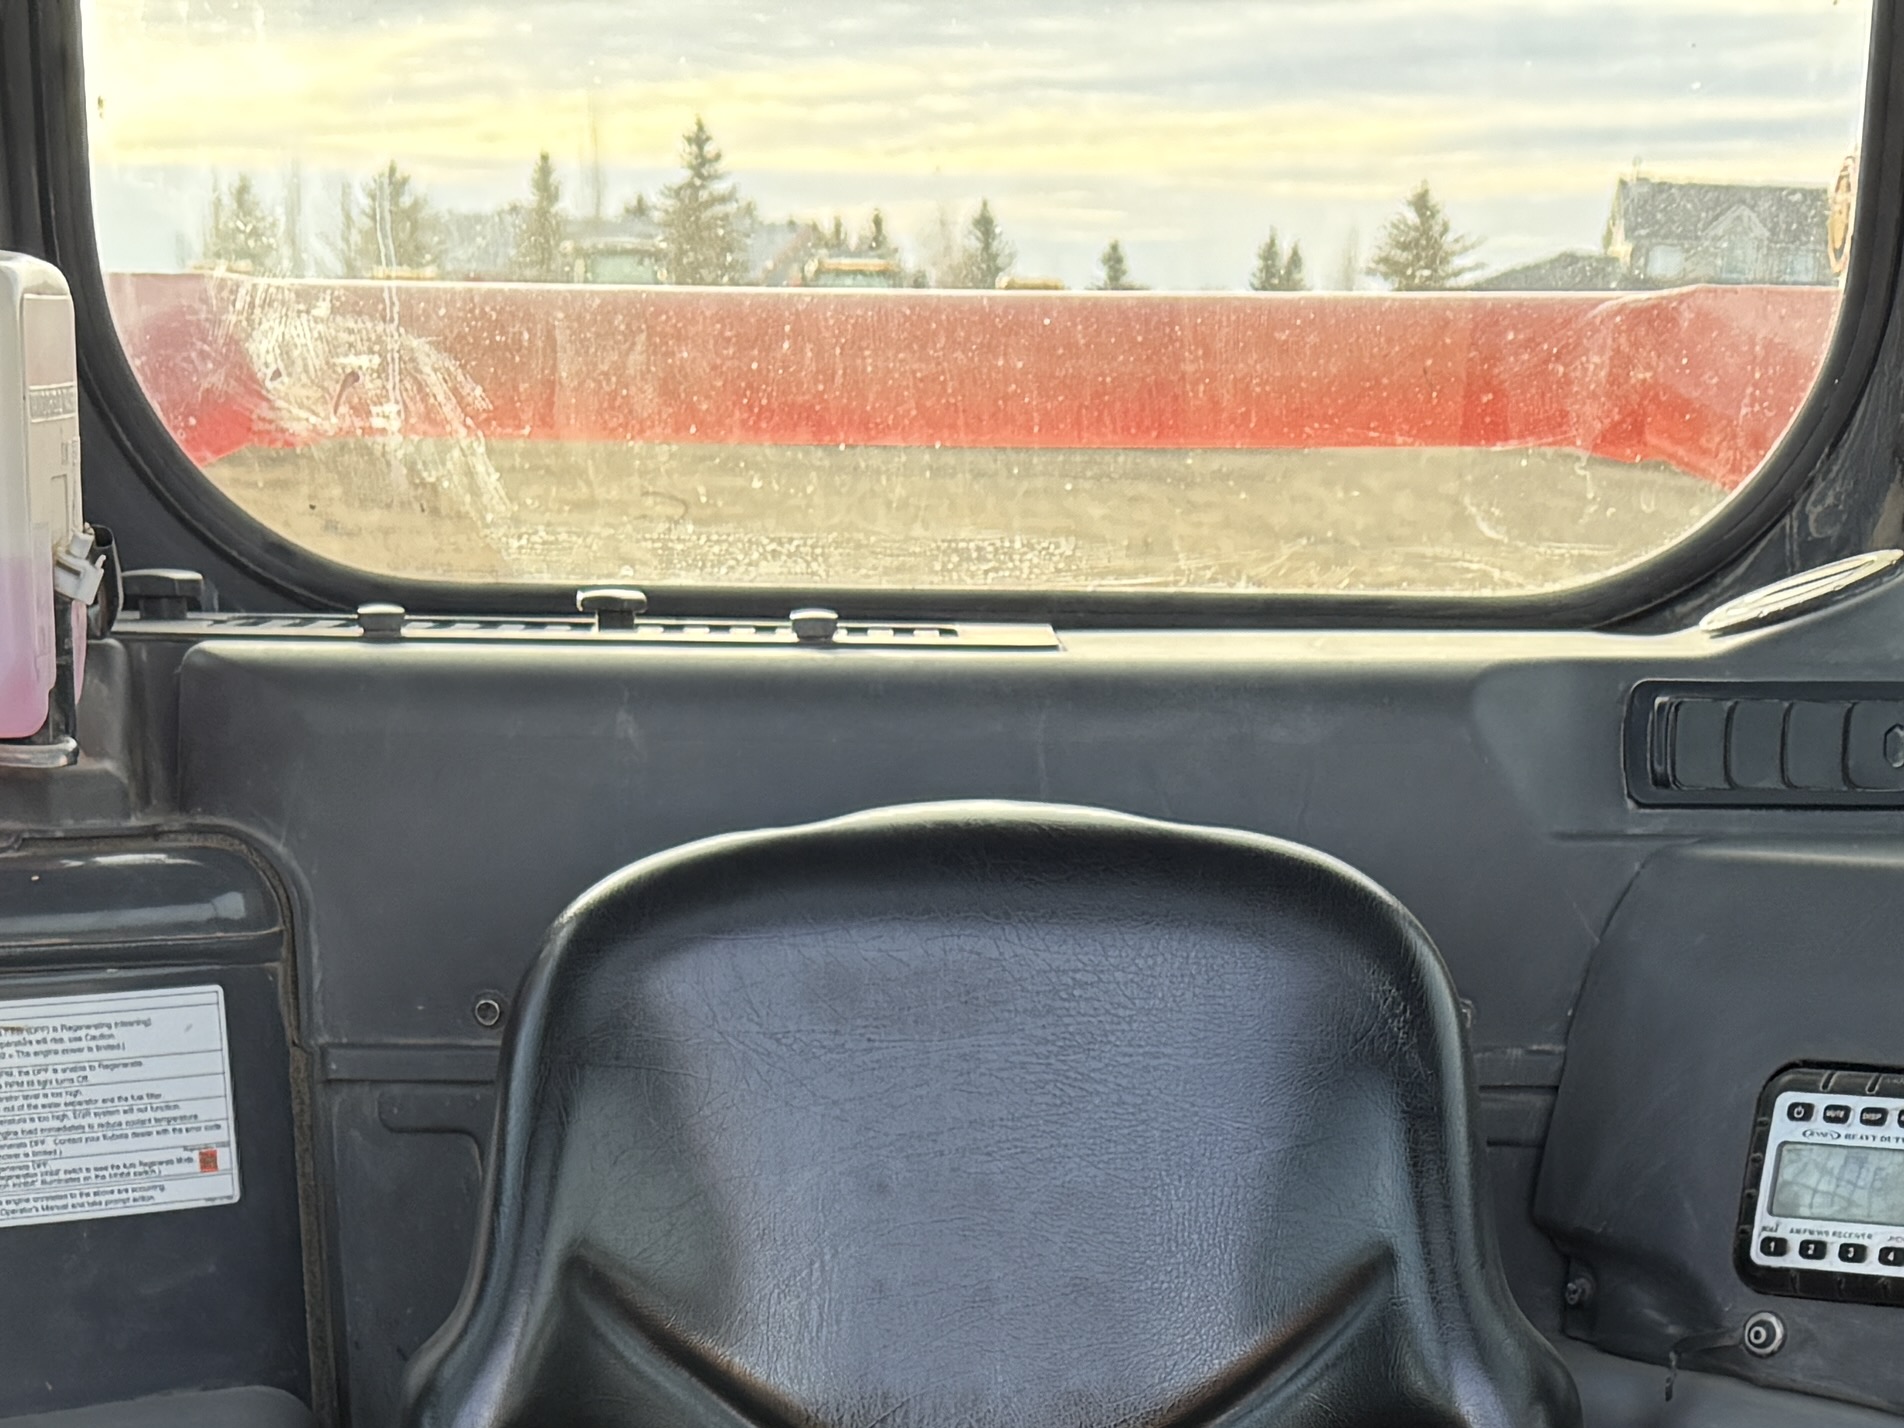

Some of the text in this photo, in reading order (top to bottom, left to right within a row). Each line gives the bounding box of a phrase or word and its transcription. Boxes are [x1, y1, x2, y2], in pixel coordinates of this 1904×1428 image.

[1769, 1239, 1775, 1251] 1
[1807, 1243, 1814, 1255] 2
[1847, 1246, 1854, 1258] 3
[1887, 1249, 1894, 1261] 4
